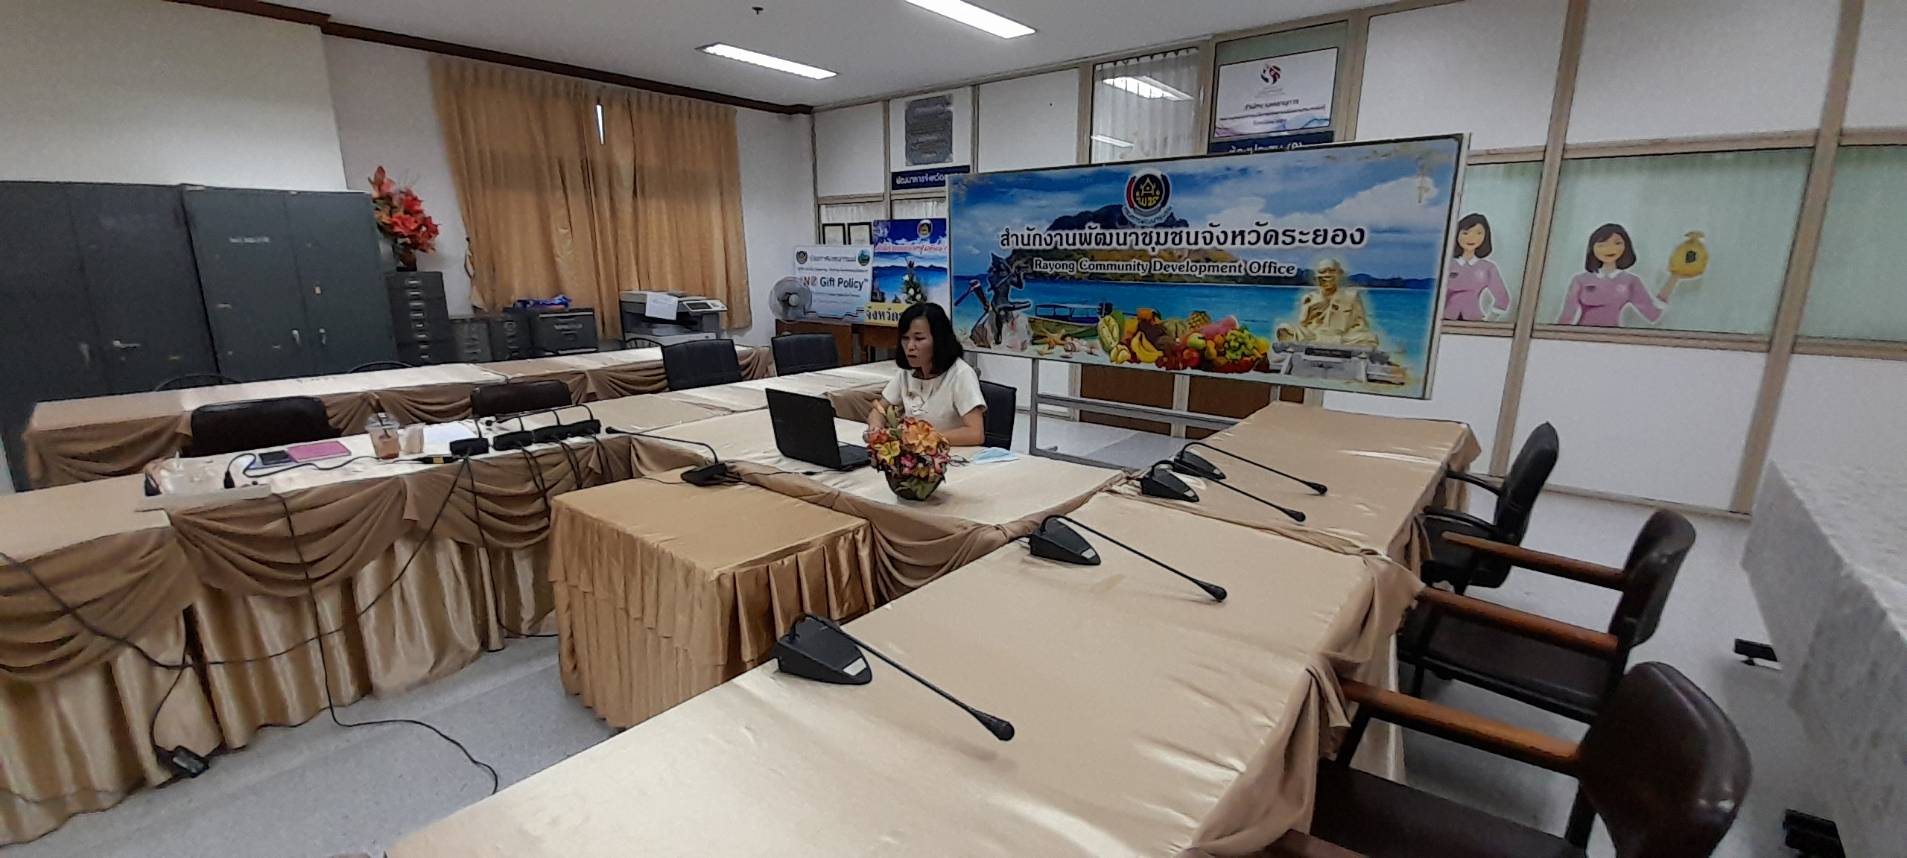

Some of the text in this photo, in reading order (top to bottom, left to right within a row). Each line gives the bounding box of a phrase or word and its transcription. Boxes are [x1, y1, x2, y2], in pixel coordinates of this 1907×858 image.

[1000, 221, 1366, 253] สำนักงานพัฒนาชุมชนจังหวัดระยอง
[1034, 259, 1296, 276] Rayong Community Development Office
[820, 276, 835, 288] Gift
